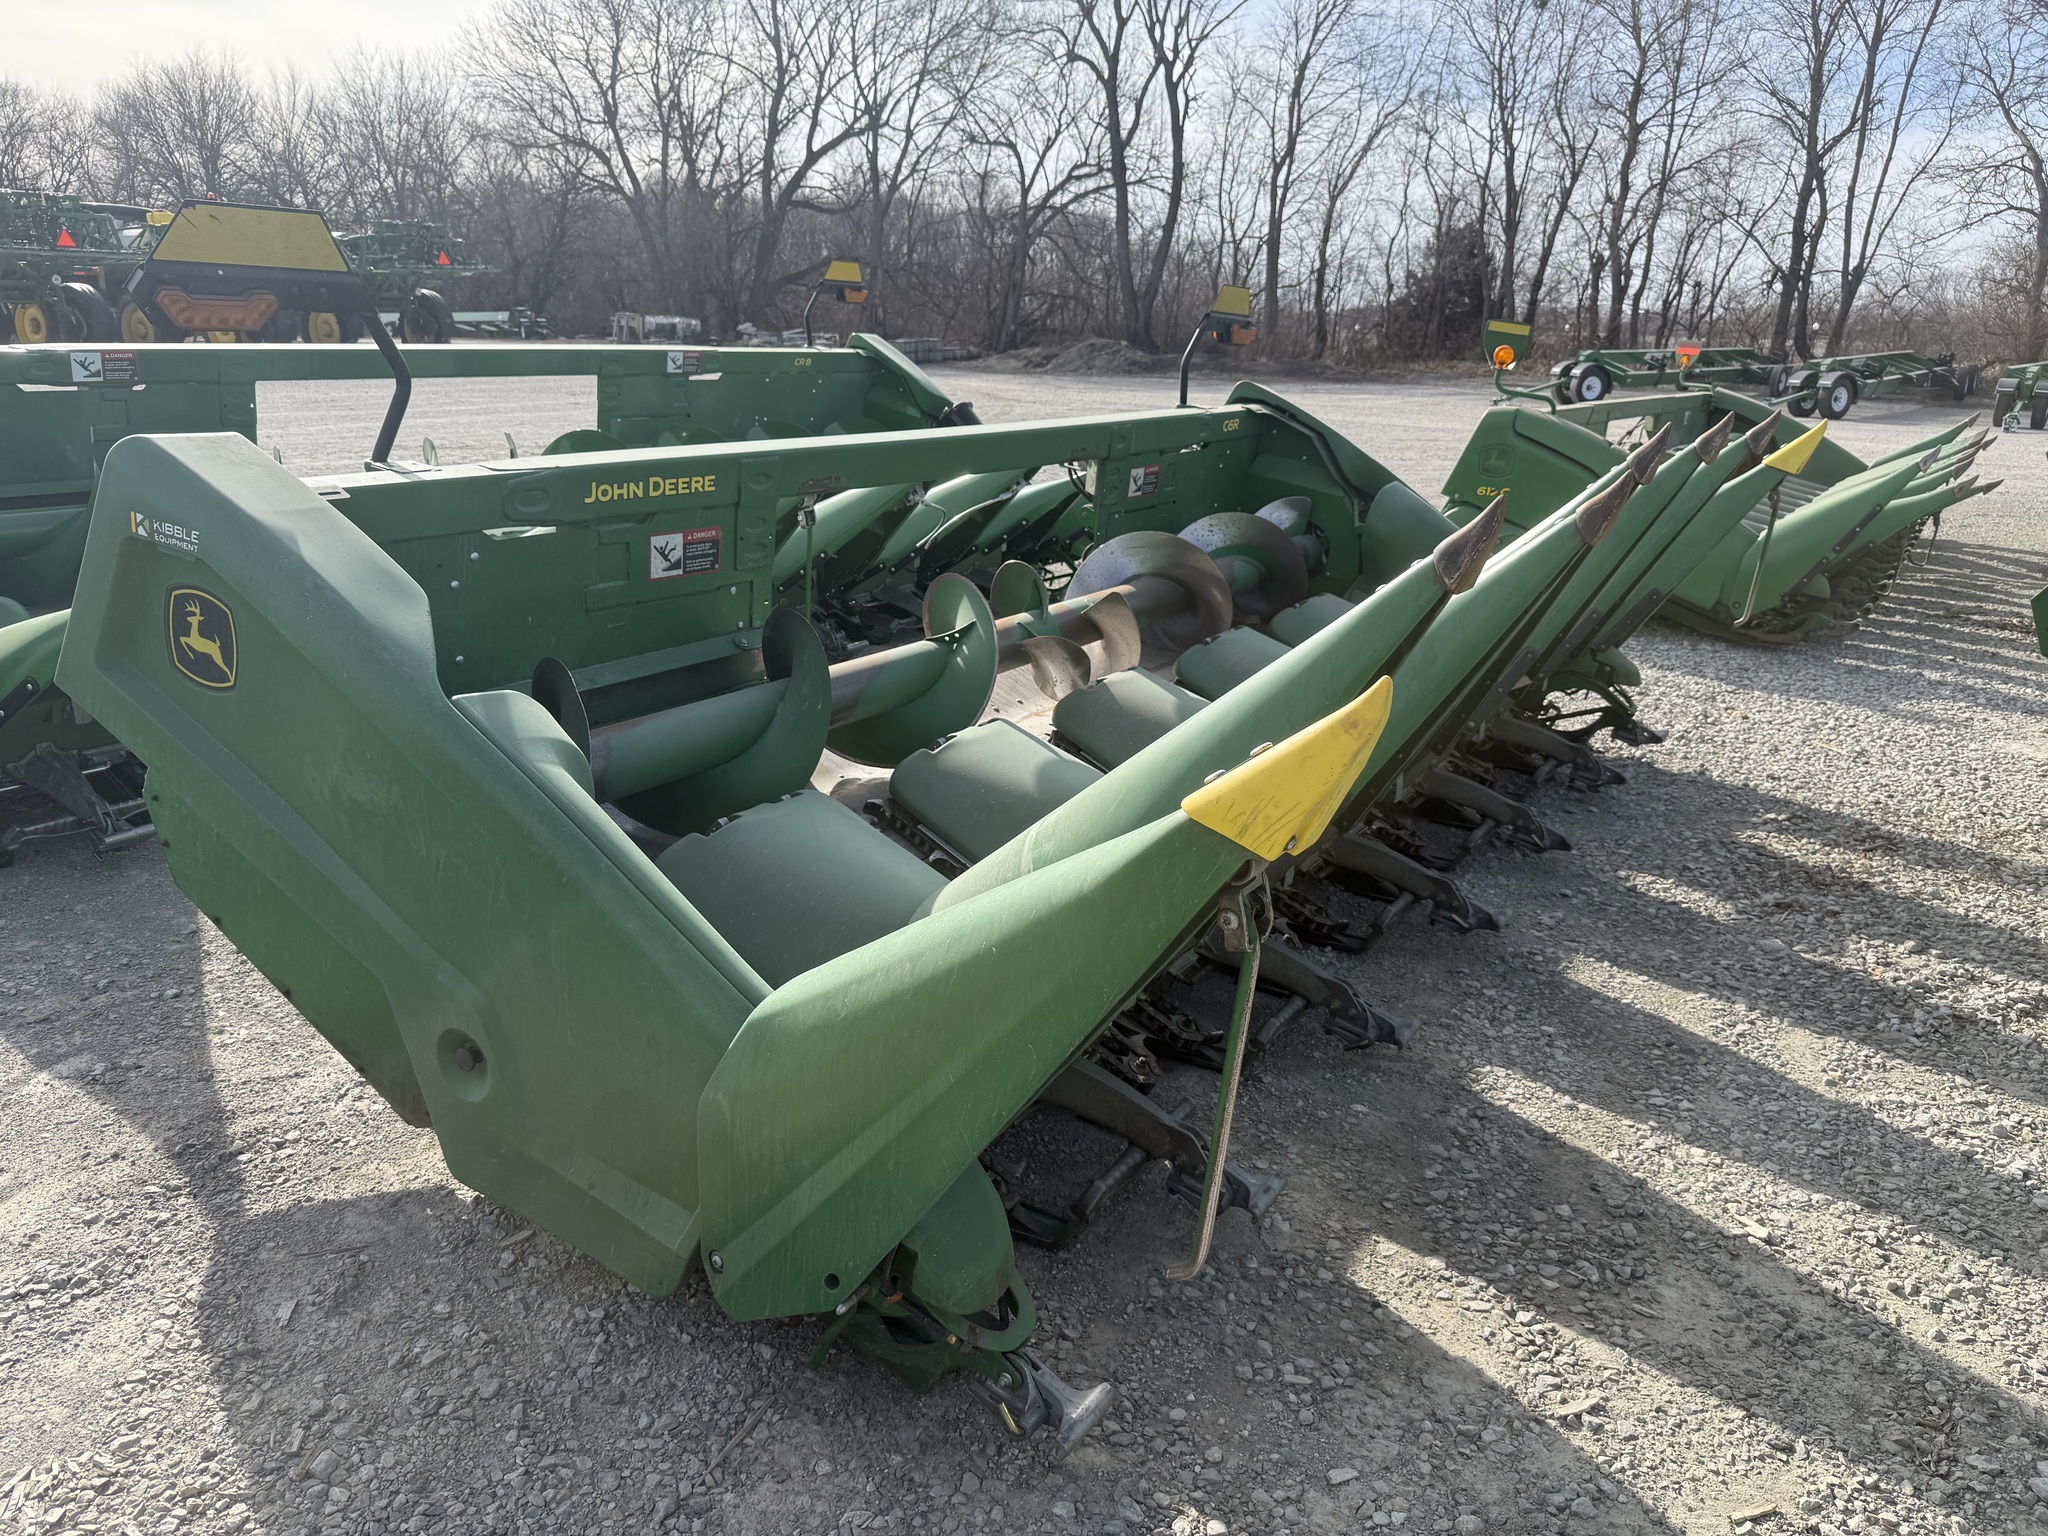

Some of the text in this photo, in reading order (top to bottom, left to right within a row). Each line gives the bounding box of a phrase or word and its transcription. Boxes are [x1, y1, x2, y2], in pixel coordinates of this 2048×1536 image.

[1223, 418, 1239, 432] C6R
[584, 475, 716, 504] JOHN DEERE
[152, 519, 200, 544] KIBBLE
[693, 530, 716, 540] DANGER
[154, 533, 199, 553] EQUIPMENT
